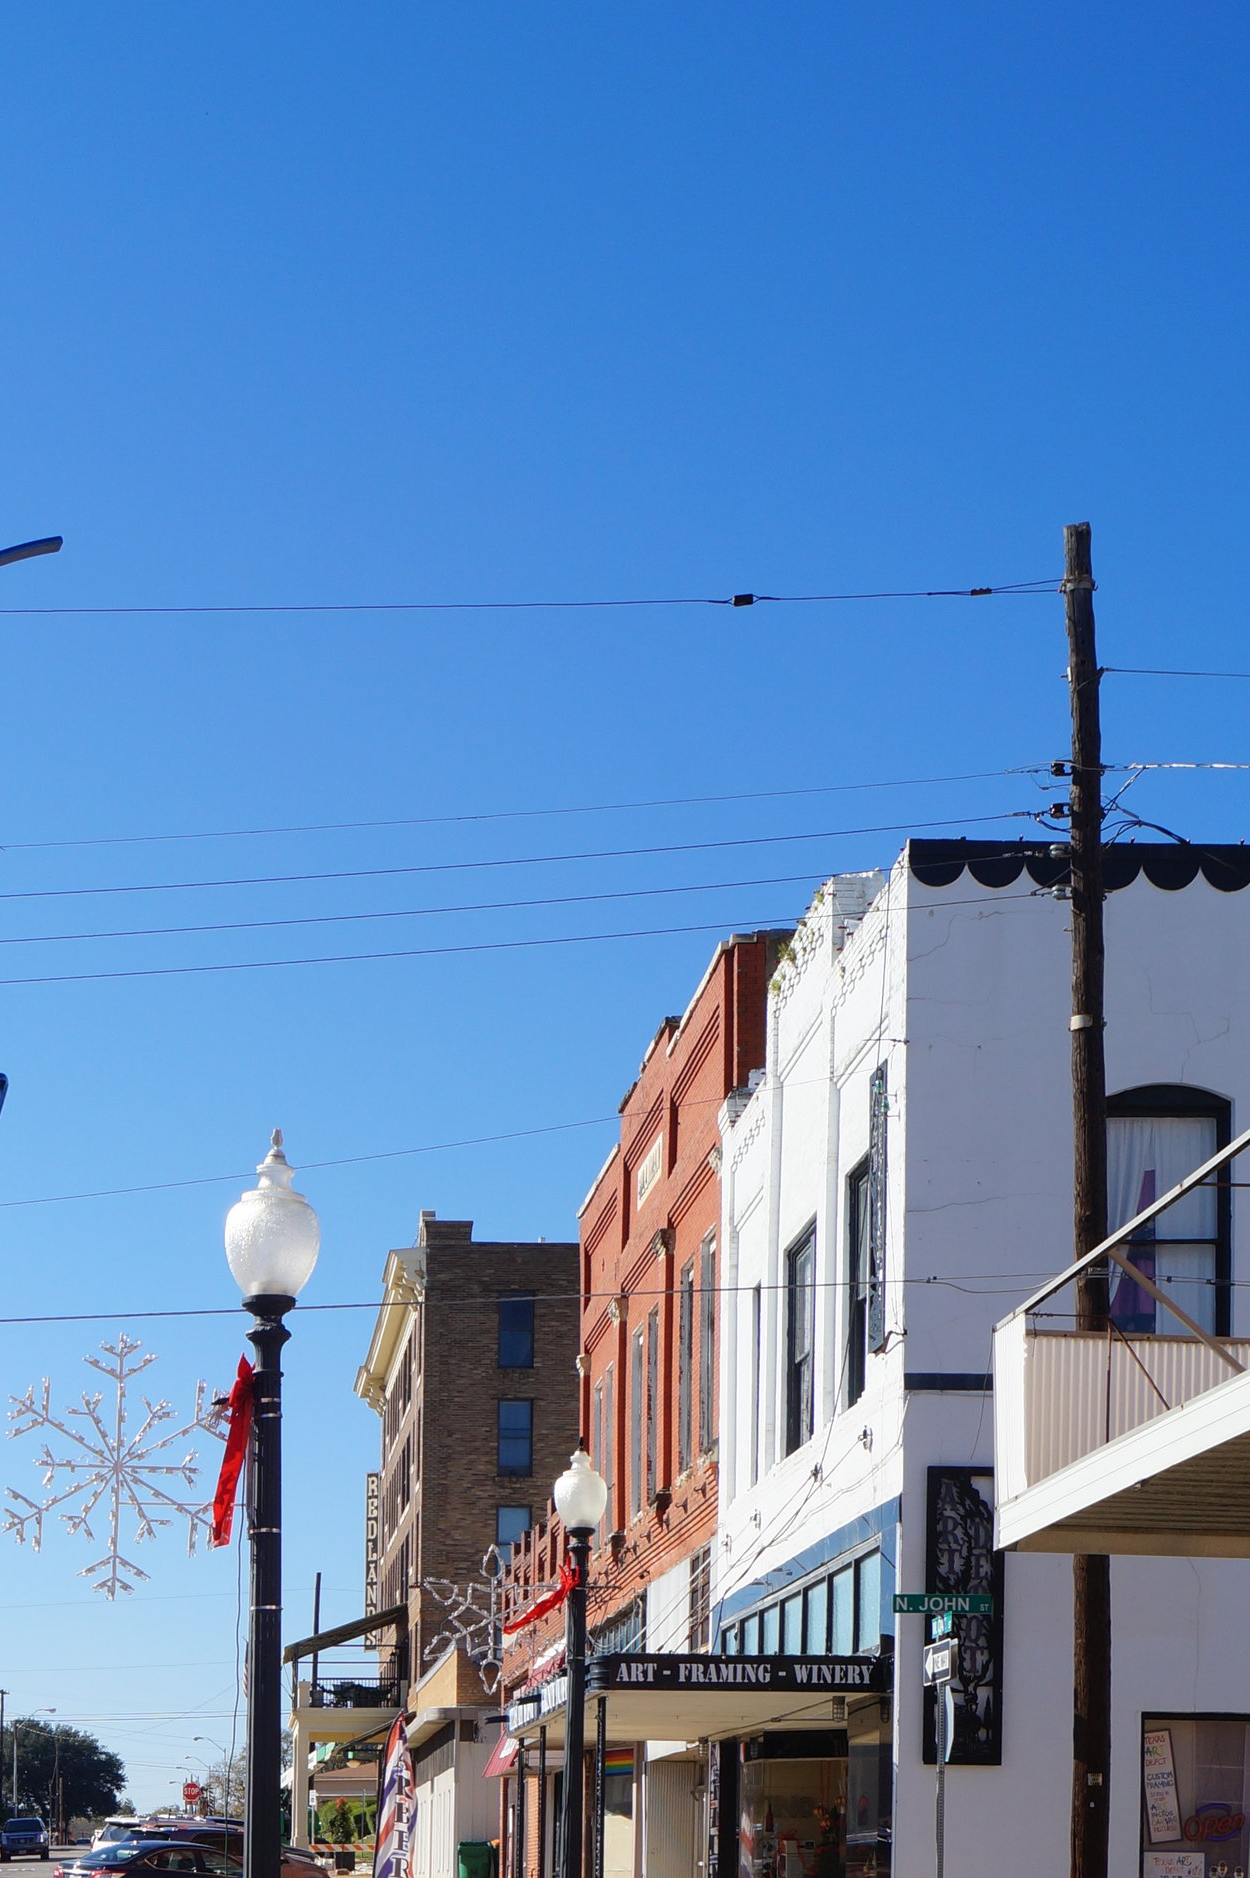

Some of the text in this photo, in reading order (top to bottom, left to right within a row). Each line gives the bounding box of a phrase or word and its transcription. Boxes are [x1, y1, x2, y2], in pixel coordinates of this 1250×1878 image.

[895, 1596, 990, 1612] N. JOHN ST
[616, 1663, 657, 1682] ART
[678, 1663, 771, 1683] FRAMING
[793, 1664, 874, 1684] WINERY
[1145, 1735, 1166, 1745] TEXAS
[1147, 1770, 1173, 1782] CUSTOM
[184, 1787, 199, 1795] STOP
